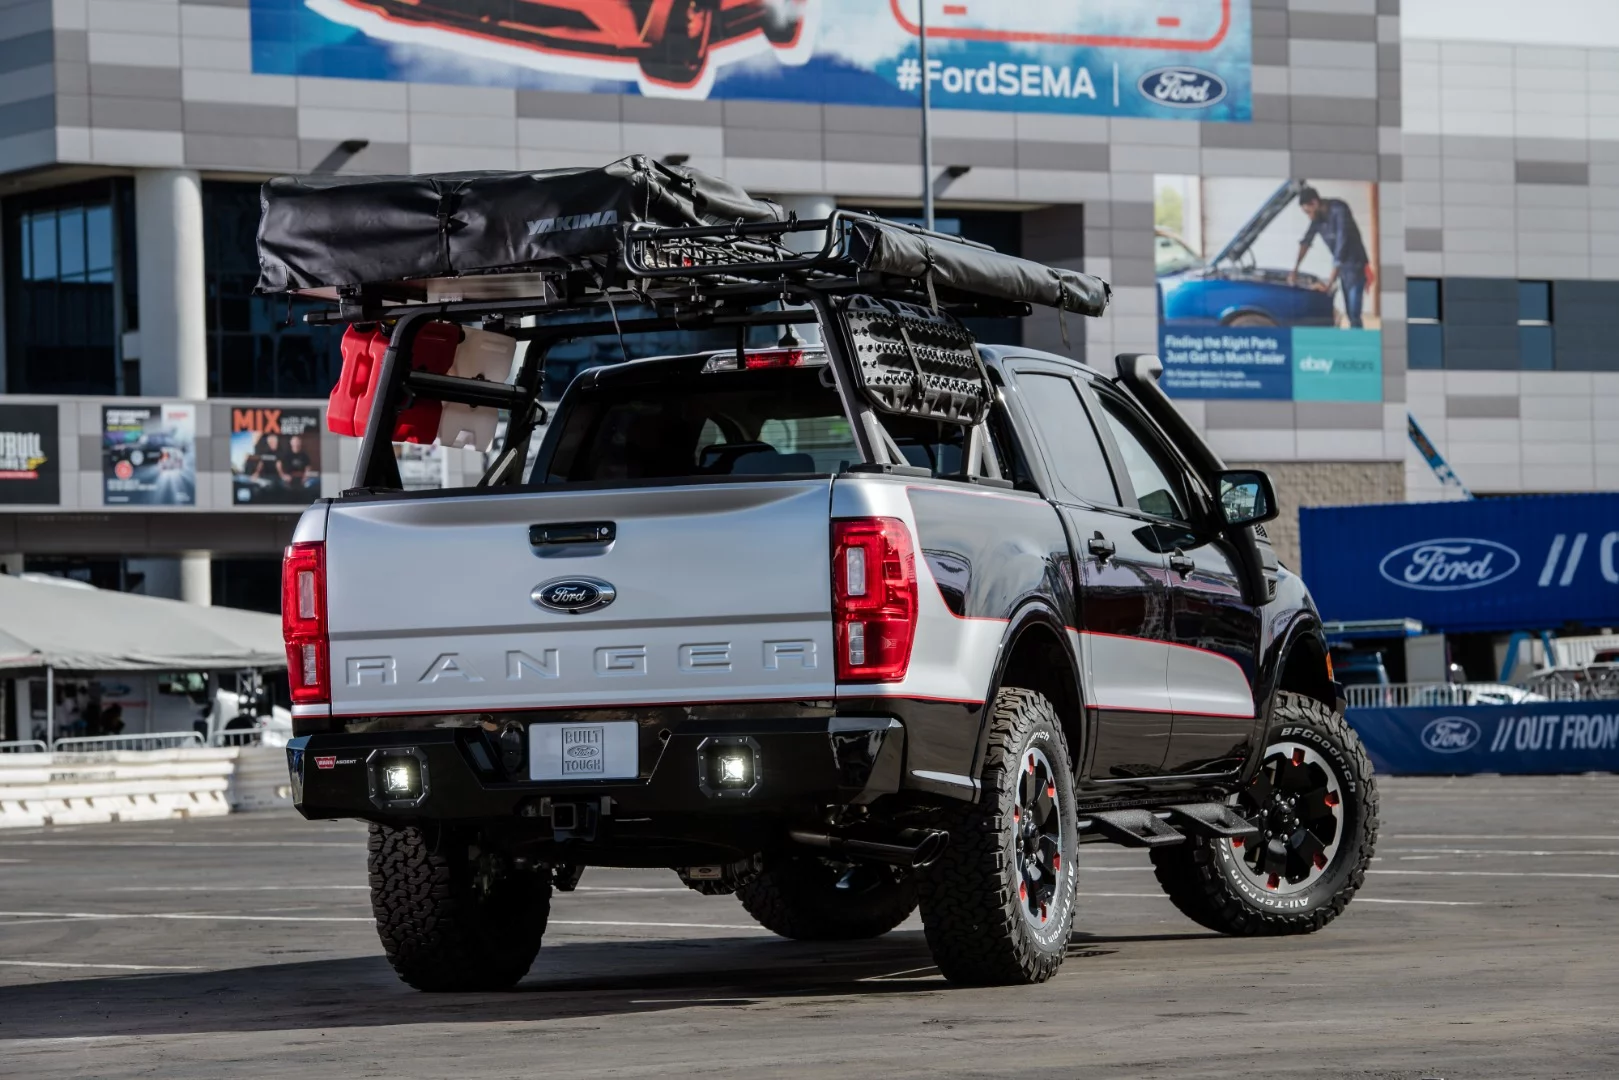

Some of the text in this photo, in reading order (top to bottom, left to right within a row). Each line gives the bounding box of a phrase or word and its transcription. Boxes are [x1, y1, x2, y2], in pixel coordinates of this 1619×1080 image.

[896, 58, 1097, 99] #FordSEMA
[526, 209, 618, 236] YAKIMA
[232, 408, 282, 434] MIX
[1404, 545, 1494, 583] Ford
[345, 638, 817, 688] RANGER
[565, 729, 601, 744] BUILT
[1515, 714, 1560, 751] OUT
[565, 759, 601, 771] TOUGH
[1280, 727, 1357, 793] BFGoodrich
